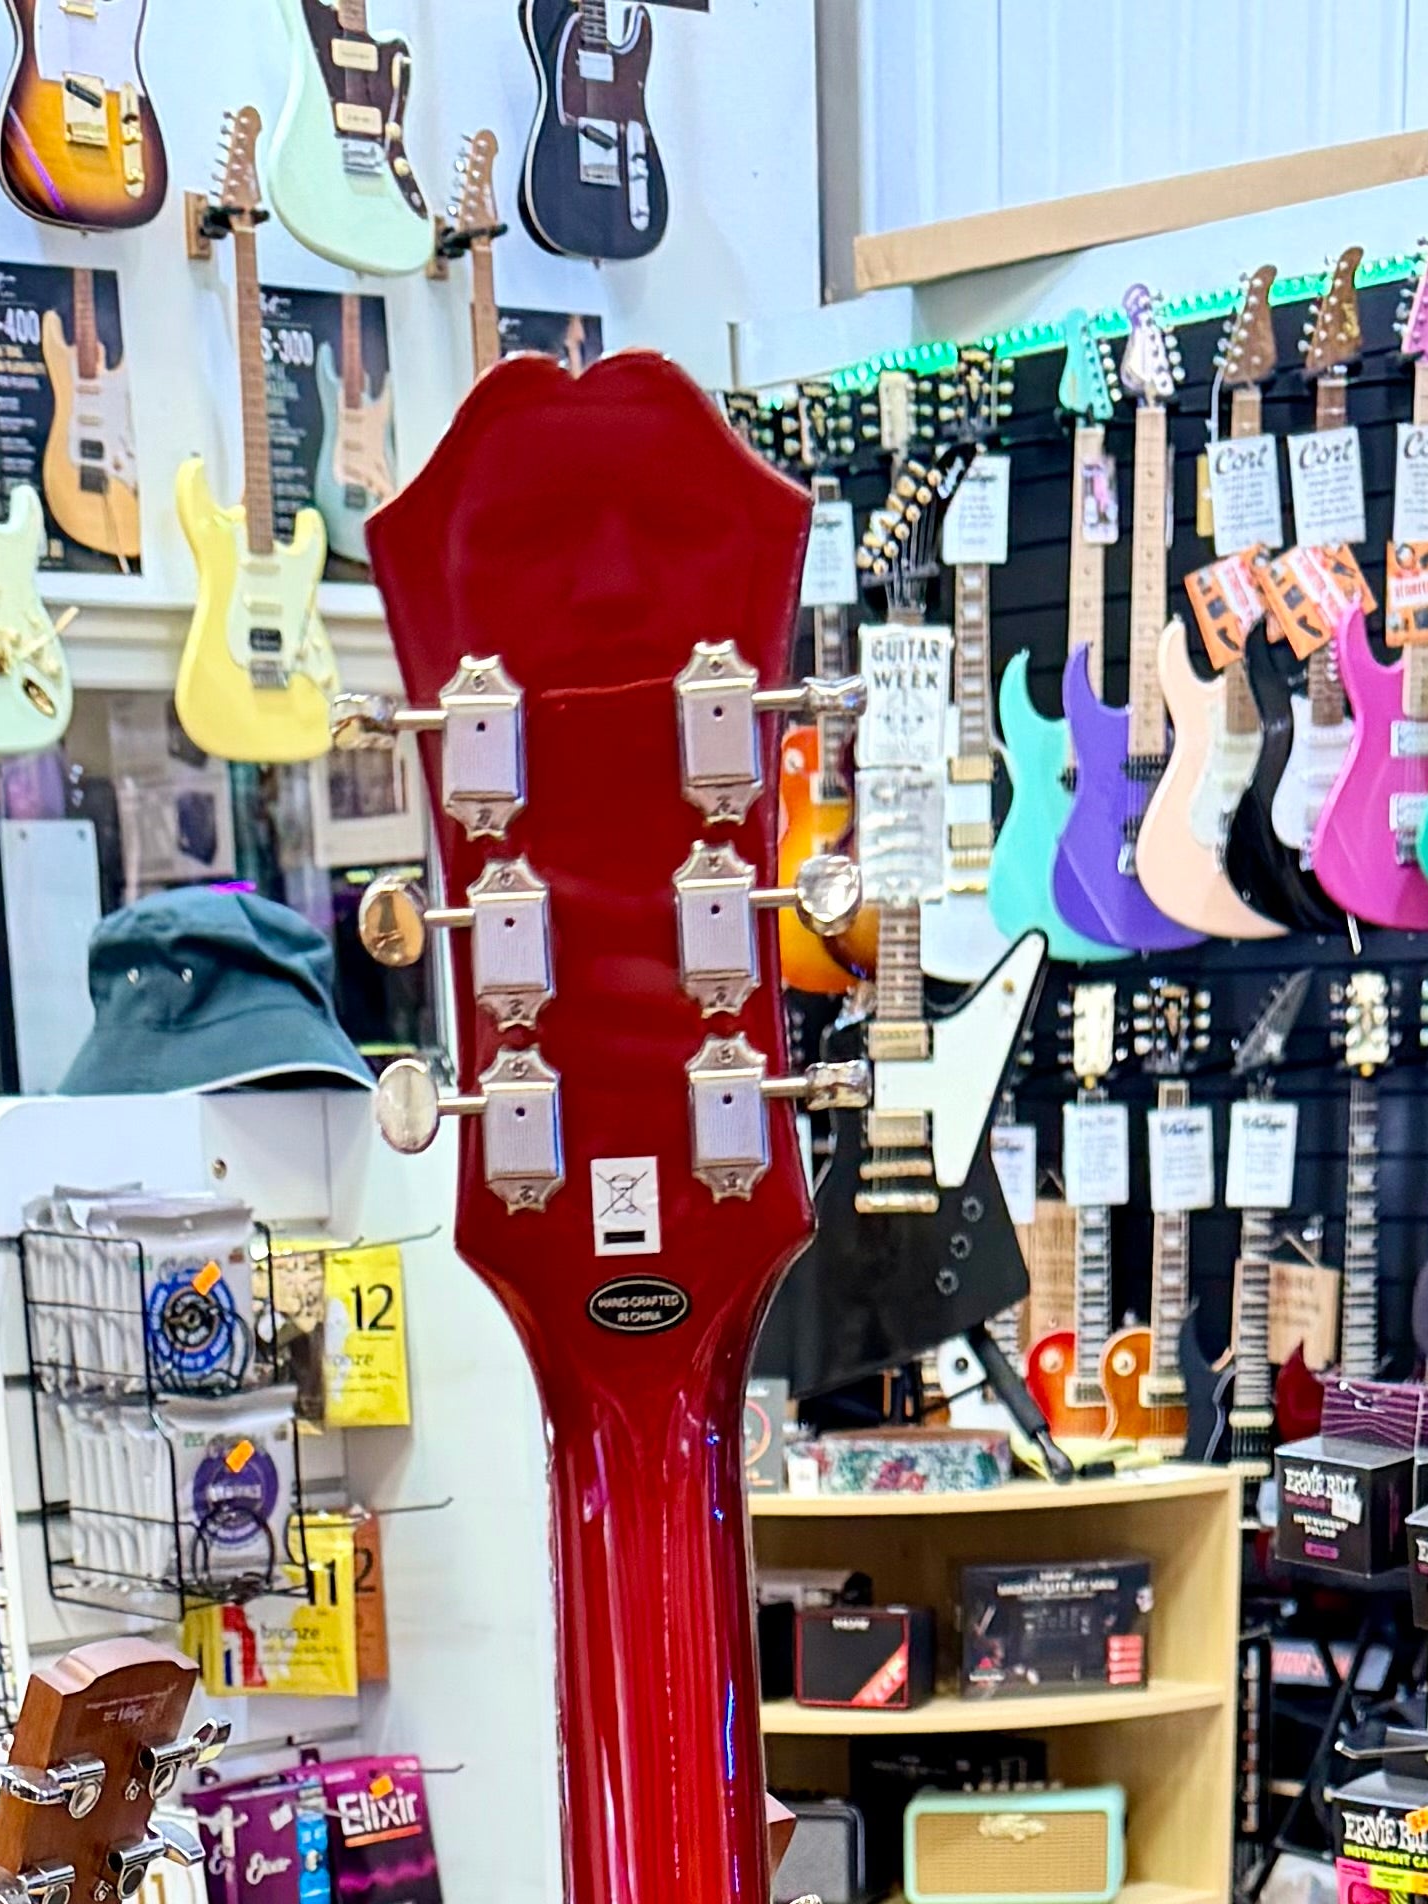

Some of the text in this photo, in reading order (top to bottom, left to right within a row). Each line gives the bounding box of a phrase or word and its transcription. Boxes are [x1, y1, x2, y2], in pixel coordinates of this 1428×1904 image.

[262, 326, 314, 367] S-300
[1215, 443, 1270, 476] Cort
[1298, 436, 1355, 471] Cort
[872, 639, 942, 666] GUITAR
[872, 668, 940, 691] WEEK
[349, 1282, 397, 1332] 12
[598, 1294, 679, 1309] HAND-CRAFTED
[617, 1310, 662, 1322] IN CHINA
[1284, 1465, 1326, 1497] ERNIE
[1292, 1511, 1350, 1532] INSTRUMENT
[1304, 1522, 1338, 1540] POLISH
[260, 1622, 322, 1642] bronze
[336, 1787, 419, 1837] Elixir
[1341, 1806, 1399, 1850] ERNIE
[1343, 1843, 1411, 1868] INSTRUMENT
